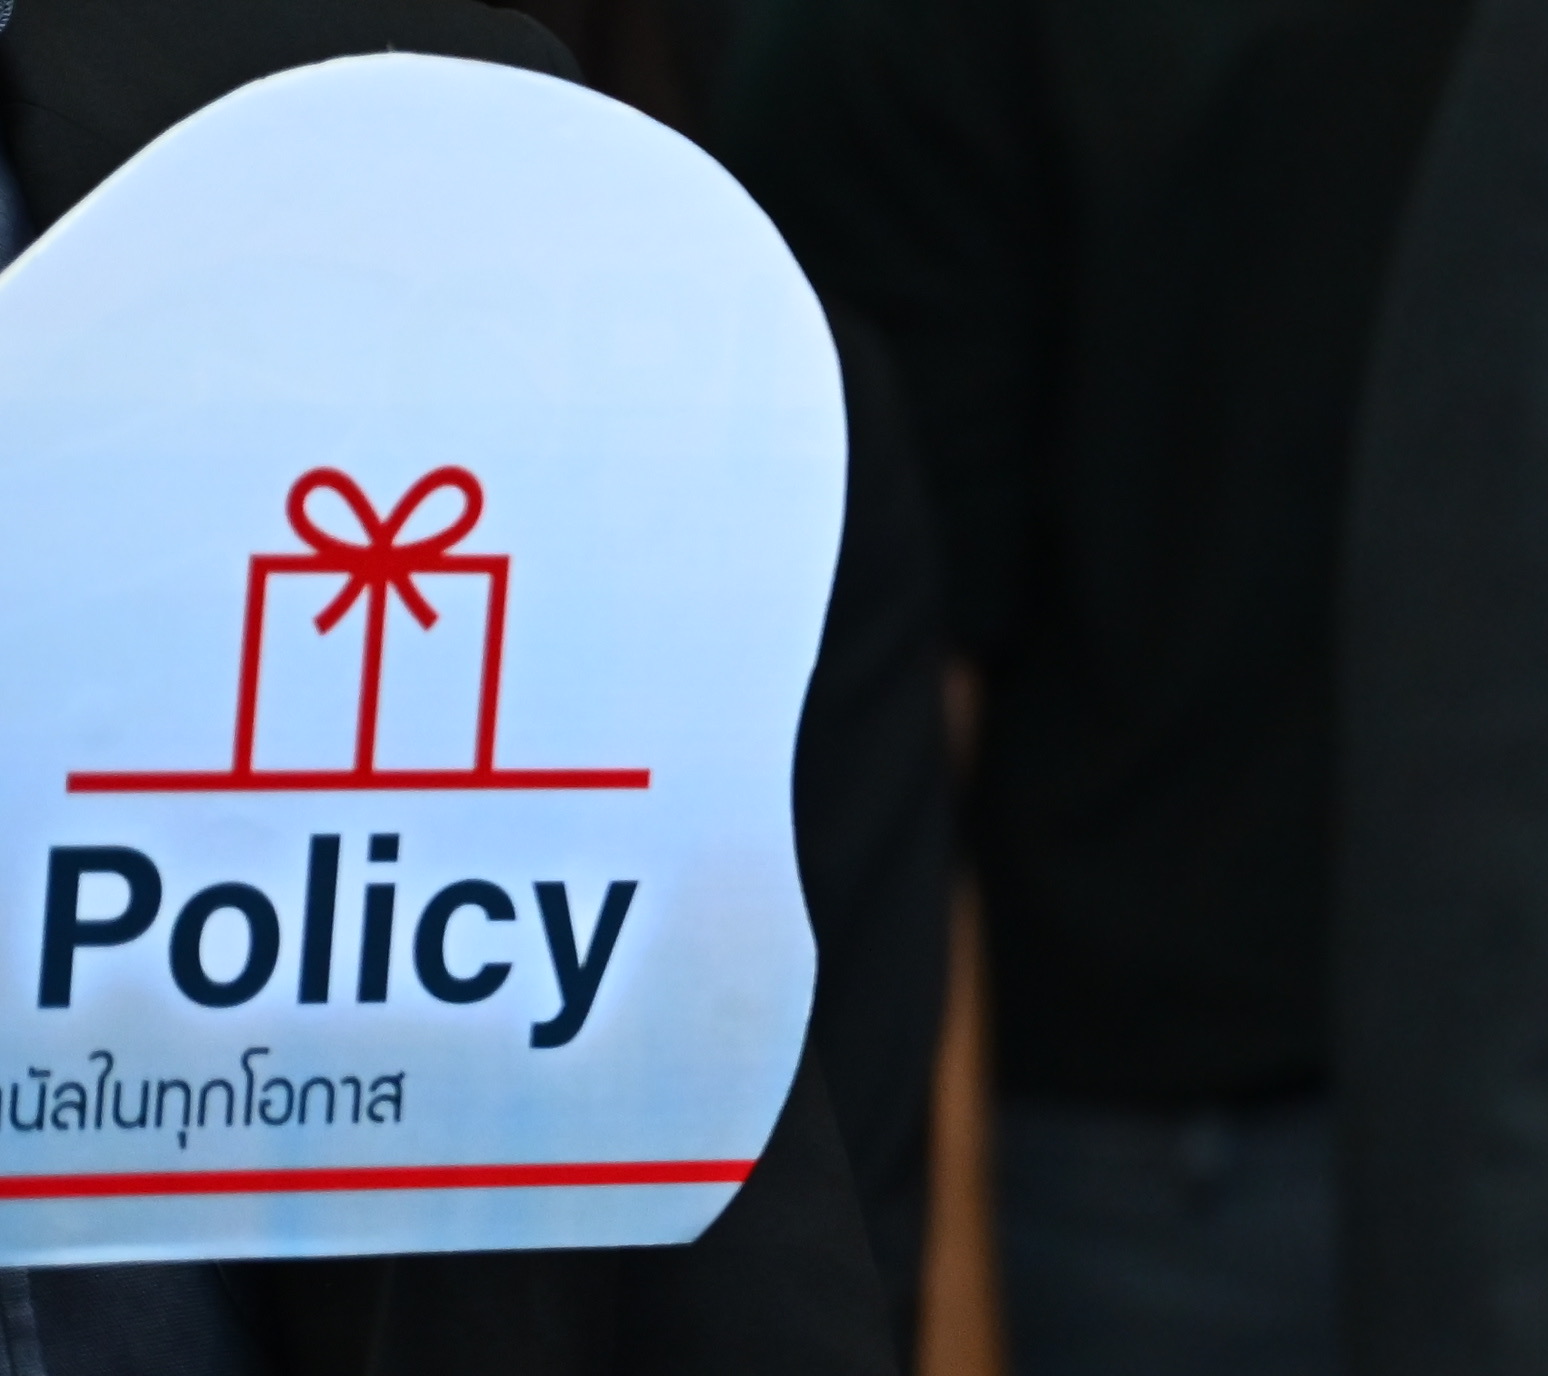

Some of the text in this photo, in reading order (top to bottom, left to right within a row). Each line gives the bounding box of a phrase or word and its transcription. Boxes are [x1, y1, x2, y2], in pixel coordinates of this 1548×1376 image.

[37, 832, 640, 1049] Policy
[0, 1048, 406, 1150] นัลในทุกโอกาส
